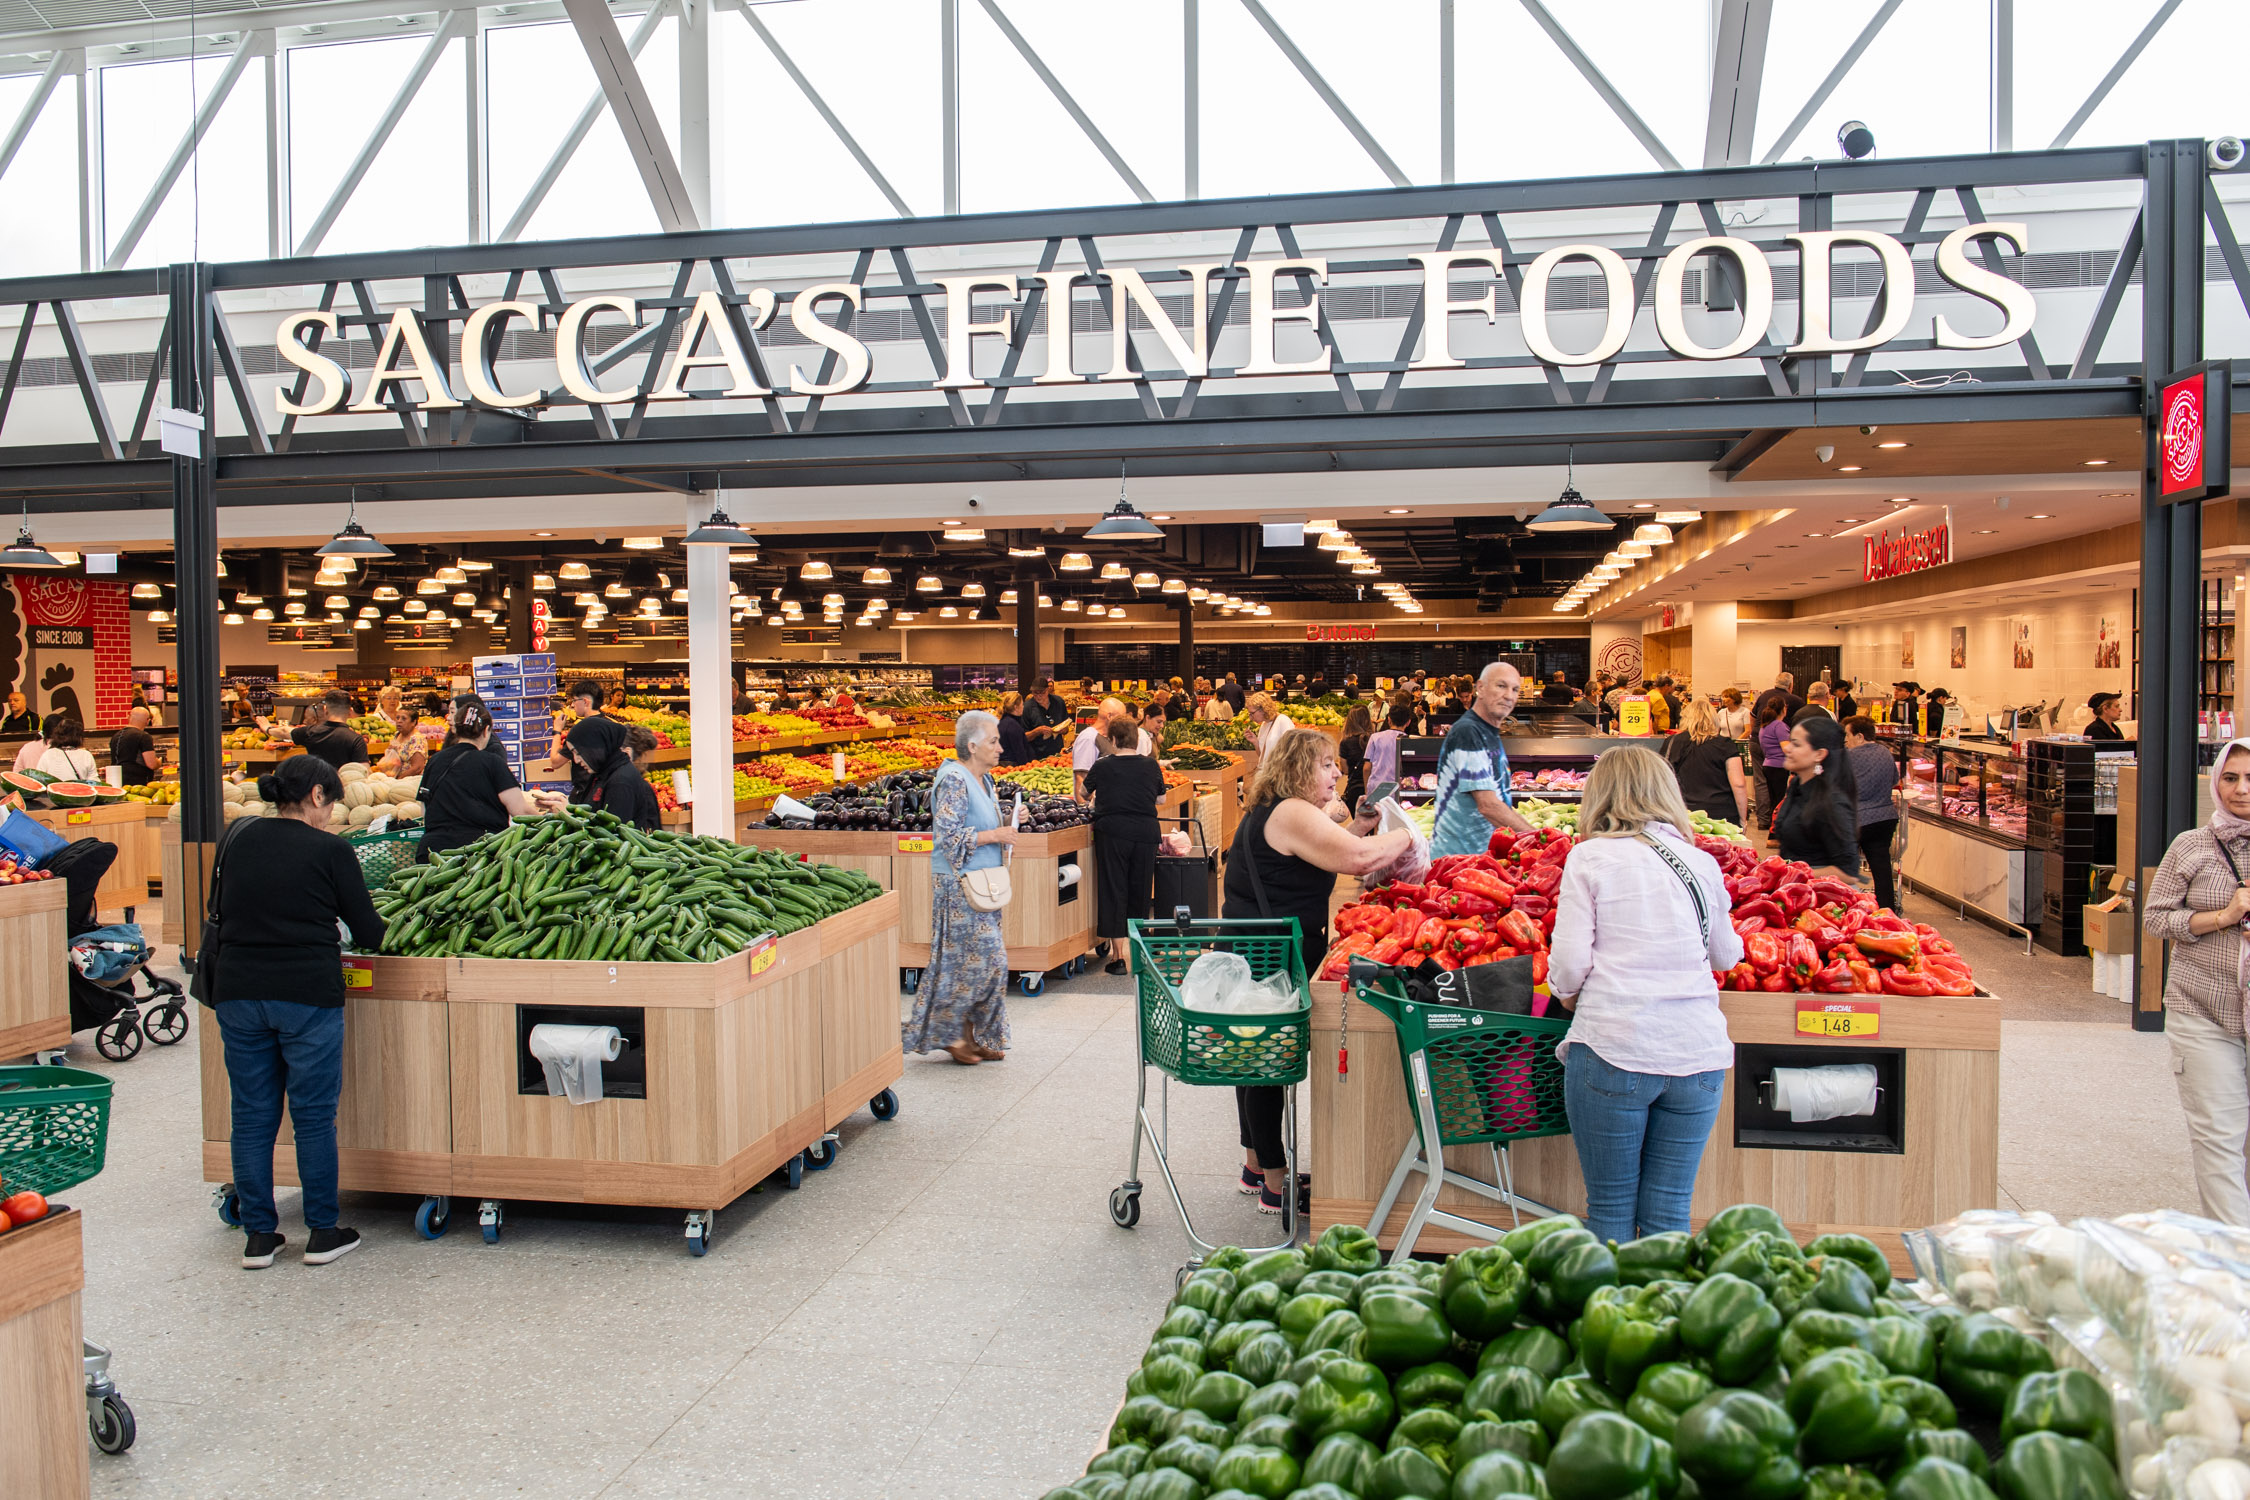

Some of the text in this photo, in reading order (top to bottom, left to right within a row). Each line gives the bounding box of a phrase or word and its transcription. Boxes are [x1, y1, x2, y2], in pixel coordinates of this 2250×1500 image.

[275, 222, 2037, 415] SACCA'S FINE FOODS
[2174, 407, 2186, 428] FINE
[2167, 409, 2199, 462] SACCA'S
[2177, 440, 2193, 464] FOODS
[1864, 523, 1949, 582] Delicatessen
[46, 598, 75, 614] FOODS
[36, 630, 84, 645] SINCE 2008
[295, 627, 304, 639] 4
[413, 625, 422, 638] 3
[1306, 624, 1380, 640] Butcher
[1627, 715, 1640, 724] 29
[1824, 1004, 1853, 1013] SPECIAL
[1822, 1018, 1851, 1033] 1.48
